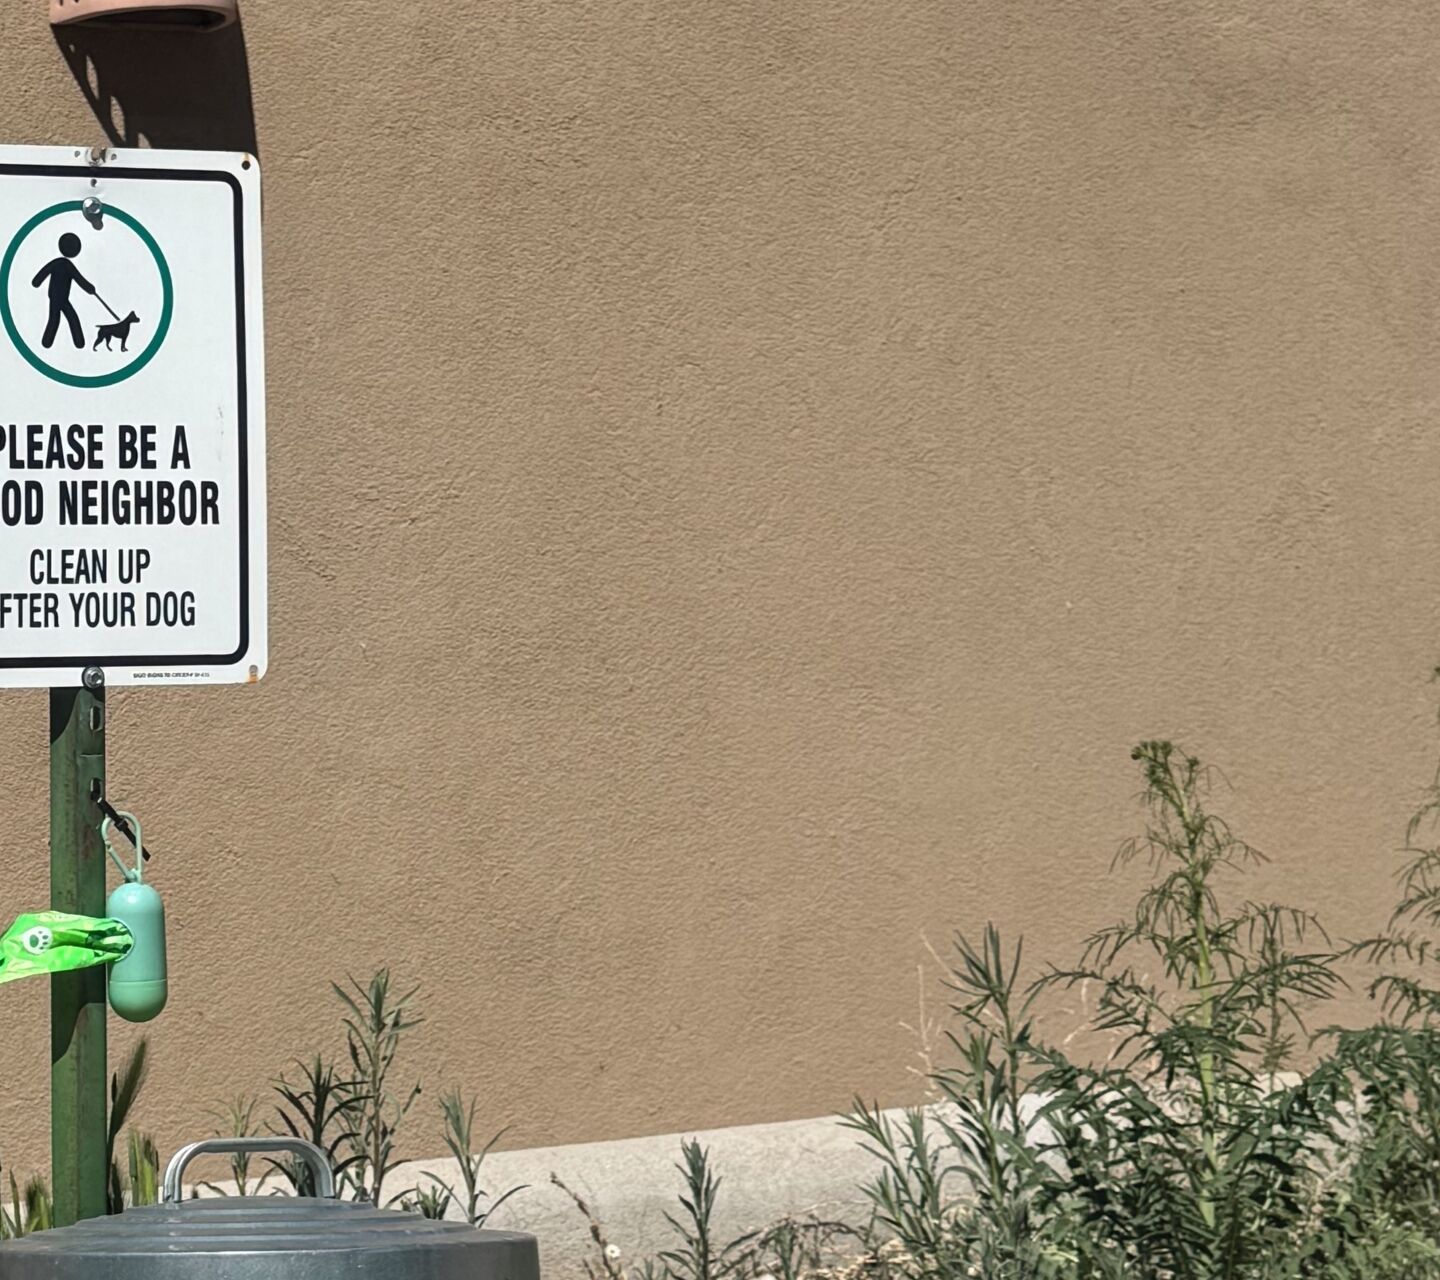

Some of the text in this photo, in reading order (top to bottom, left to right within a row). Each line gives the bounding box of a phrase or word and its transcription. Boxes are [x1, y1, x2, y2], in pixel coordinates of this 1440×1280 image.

[118, 424, 157, 470] BE
[170, 425, 191, 470] A
[59, 479, 220, 526] NEIGHBOR
[29, 548, 151, 585] CLEAN UP
[68, 591, 136, 628] YOUR
[146, 590, 195, 627] DOG
